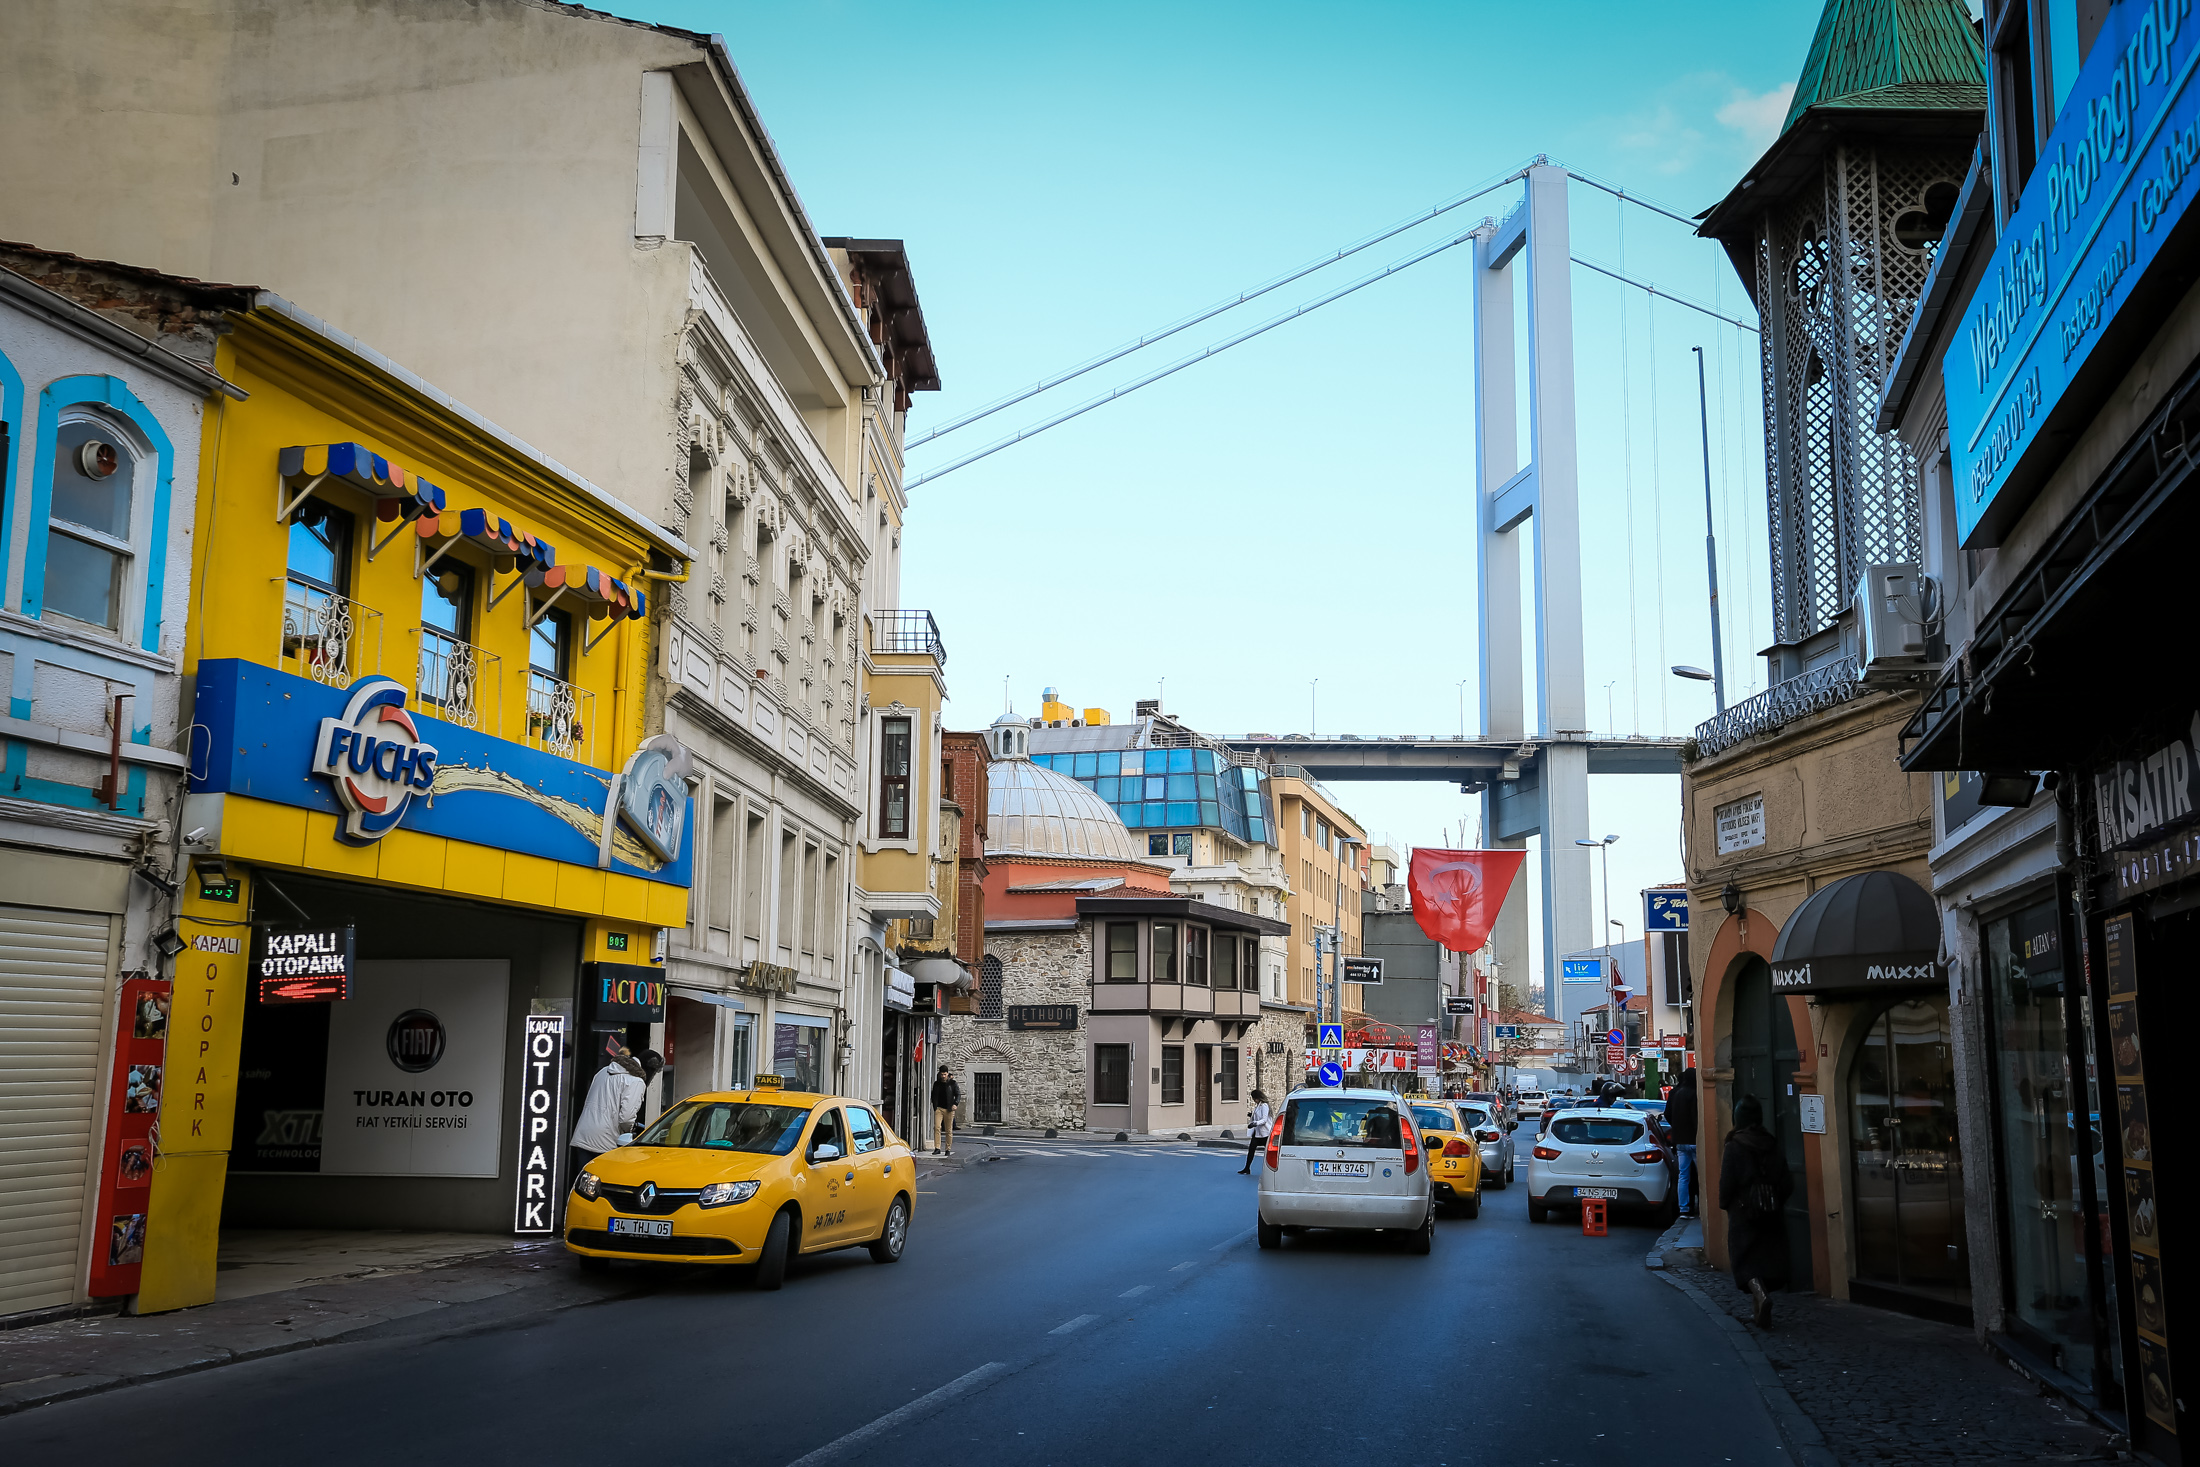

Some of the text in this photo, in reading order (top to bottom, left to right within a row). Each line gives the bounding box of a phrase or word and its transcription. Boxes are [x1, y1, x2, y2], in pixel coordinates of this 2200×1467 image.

[1970, 0, 2193, 394] Wedding Photograp
[1971, 445, 1994, 504] 0542
[1992, 414, 2012, 472] 204
[2011, 393, 2025, 441] 01
[2025, 366, 2042, 419] 34
[2059, 240, 2129, 364] Instagram
[327, 727, 437, 790] FUCHS
[190, 934, 240, 954] KAPALI
[267, 932, 336, 956] KAPALI
[261, 954, 345, 976] OTOPARK
[602, 978, 664, 1006] FACTORY
[1012, 1008, 1072, 1020] KETHUDA
[529, 1020, 562, 1034] KAPALI
[1420, 1030, 1433, 1039] 24
[192, 963, 218, 1137] OTOPARK
[401, 1028, 434, 1056] FIAT
[353, 1090, 474, 1108] TURAN OTO
[356, 1114, 468, 1129] FIAT YETKİLİ SERVİSİ
[525, 1034, 554, 1227] OTOPARK
[1319, 1163, 1365, 1173] 34 HK 9746
[1444, 1160, 1457, 1169] 59
[614, 1220, 669, 1235] 34 THJ 05
[824, 1212, 837, 1227] THJ
[837, 1210, 845, 1223] 05
